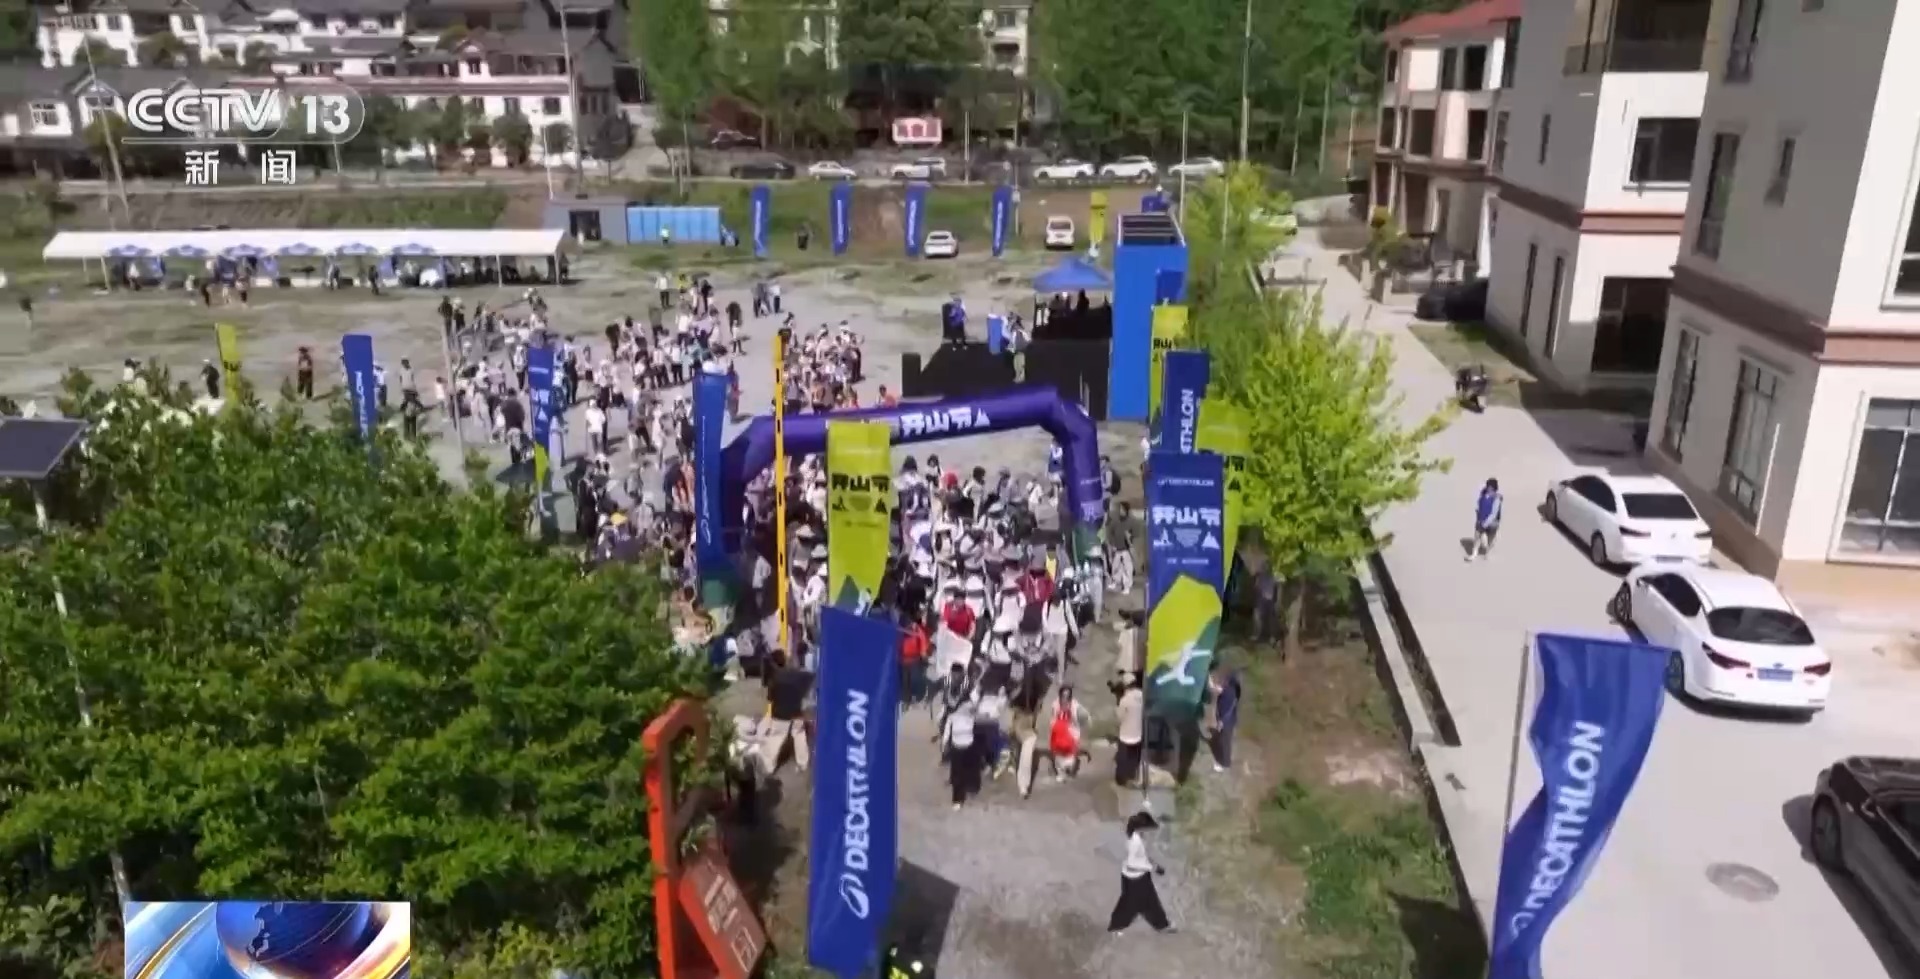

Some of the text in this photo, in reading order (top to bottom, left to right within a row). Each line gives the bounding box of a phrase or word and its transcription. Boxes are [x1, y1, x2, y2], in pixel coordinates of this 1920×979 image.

[900, 407, 973, 438] 开山节
[1152, 505, 1222, 526] 开山节
[845, 688, 870, 871] DECATHLON
[1523, 720, 1604, 910] DECATHLON
